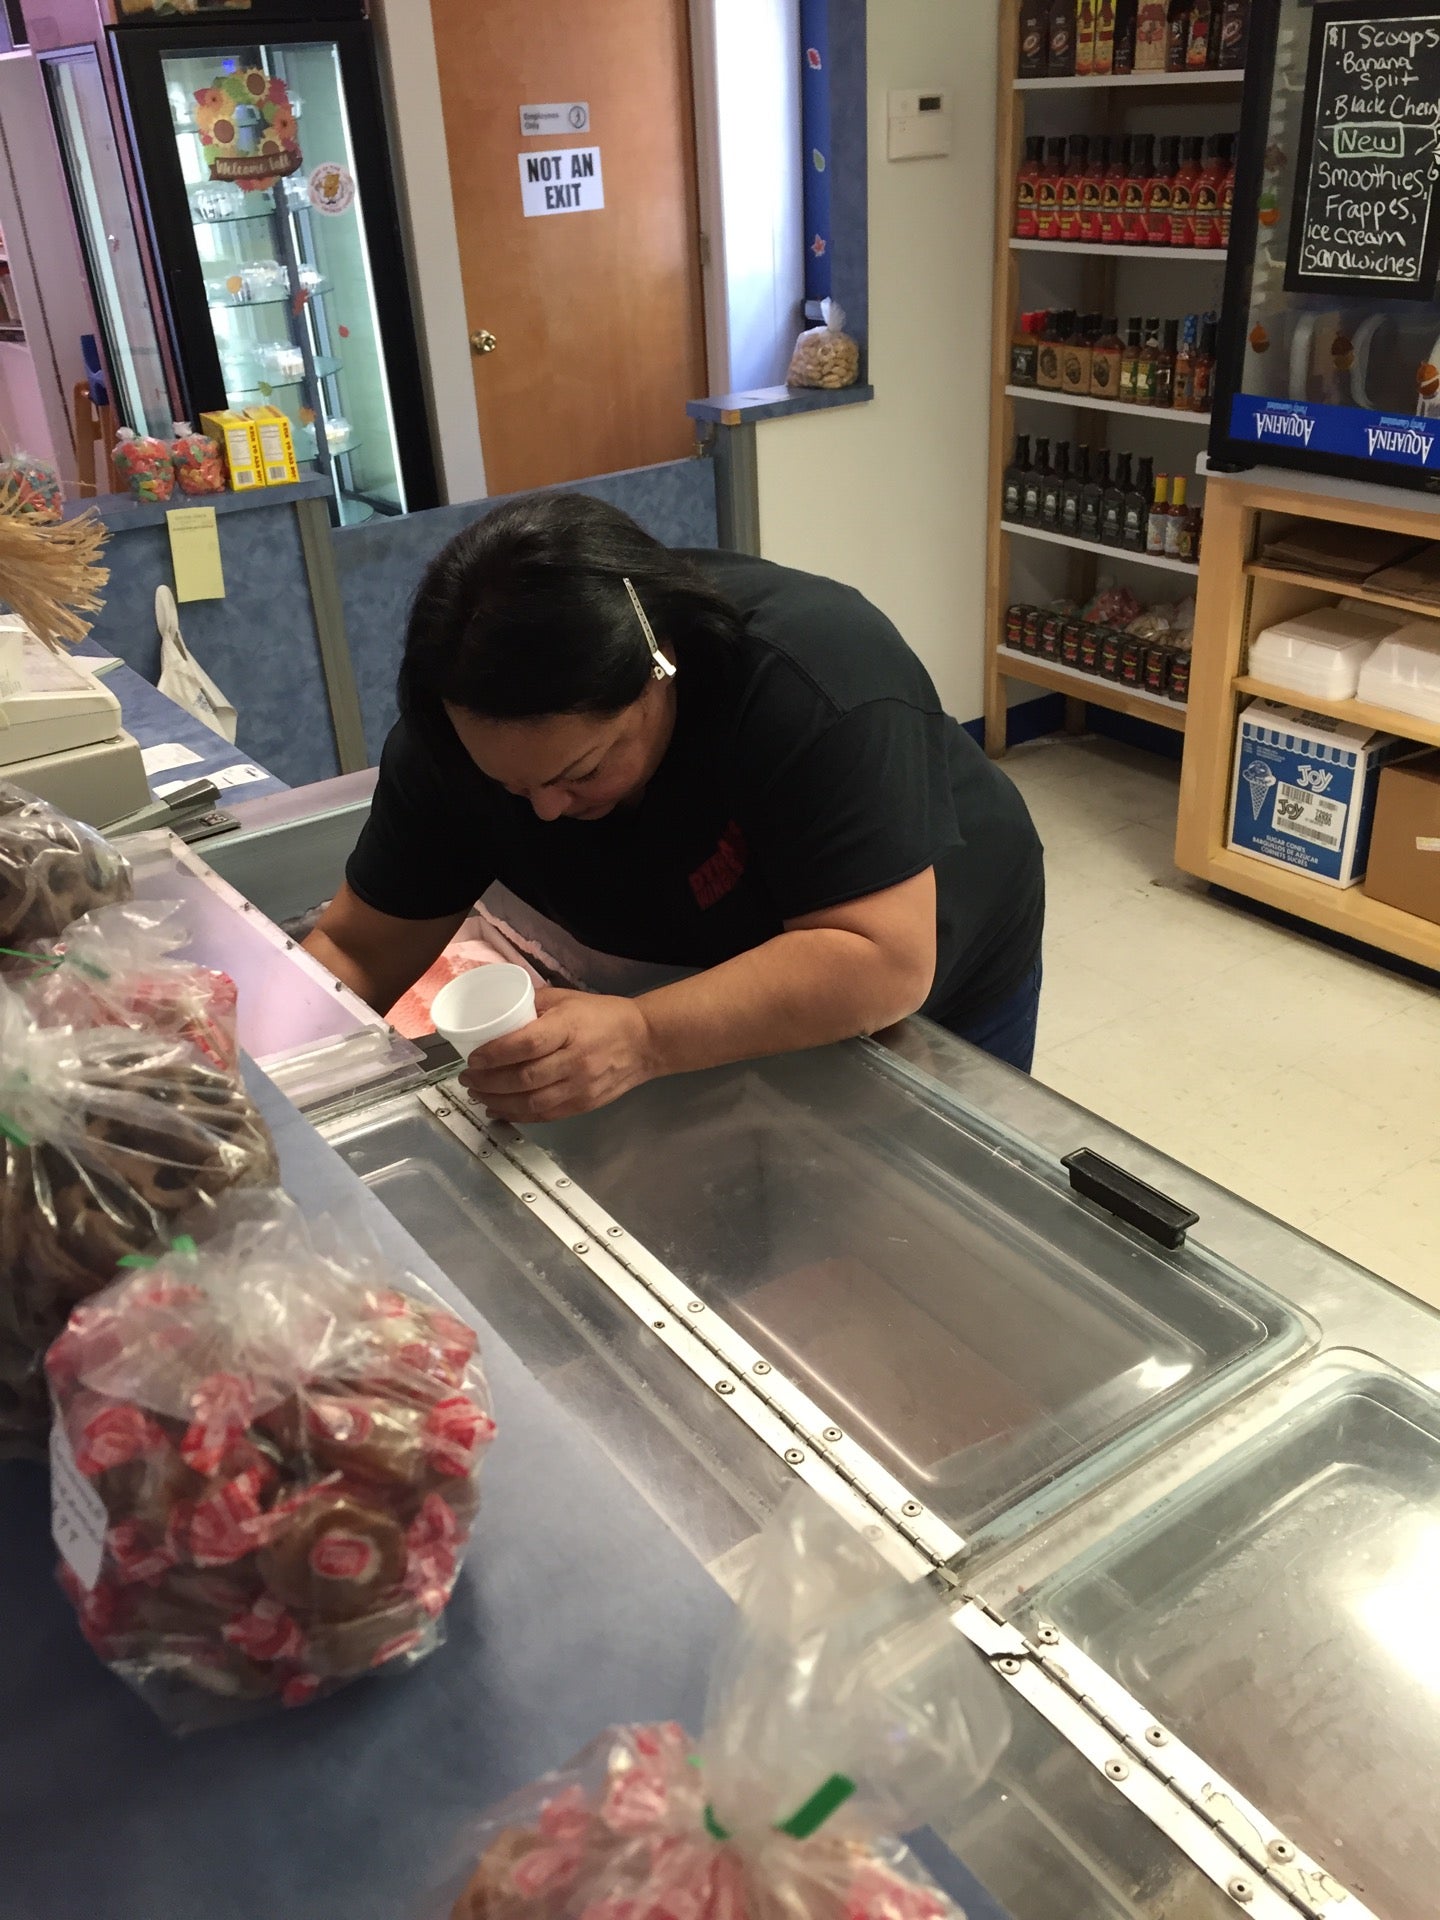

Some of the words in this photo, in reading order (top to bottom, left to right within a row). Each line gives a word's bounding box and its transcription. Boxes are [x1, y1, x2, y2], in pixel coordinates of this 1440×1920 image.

[1358, 24, 1440, 58] Scoops
[1343, 51, 1413, 74] Banana
[1360, 73, 1419, 93] Split
[1334, 94, 1386, 120] Black
[1340, 130, 1397, 151] New
[215, 159, 267, 177] Welcome
[527, 156, 562, 183] NOT
[571, 153, 594, 178] AN
[545, 183, 582, 210] EXIT
[1307, 218, 1331, 242] ice
[1334, 226, 1406, 246] cream
[1255, 412, 1316, 447] AQUAFINA
[1367, 428, 1435, 465] AQUAFINA
[1266, 834, 1285, 846] SUGAR
[1285, 841, 1306, 853] CONES
